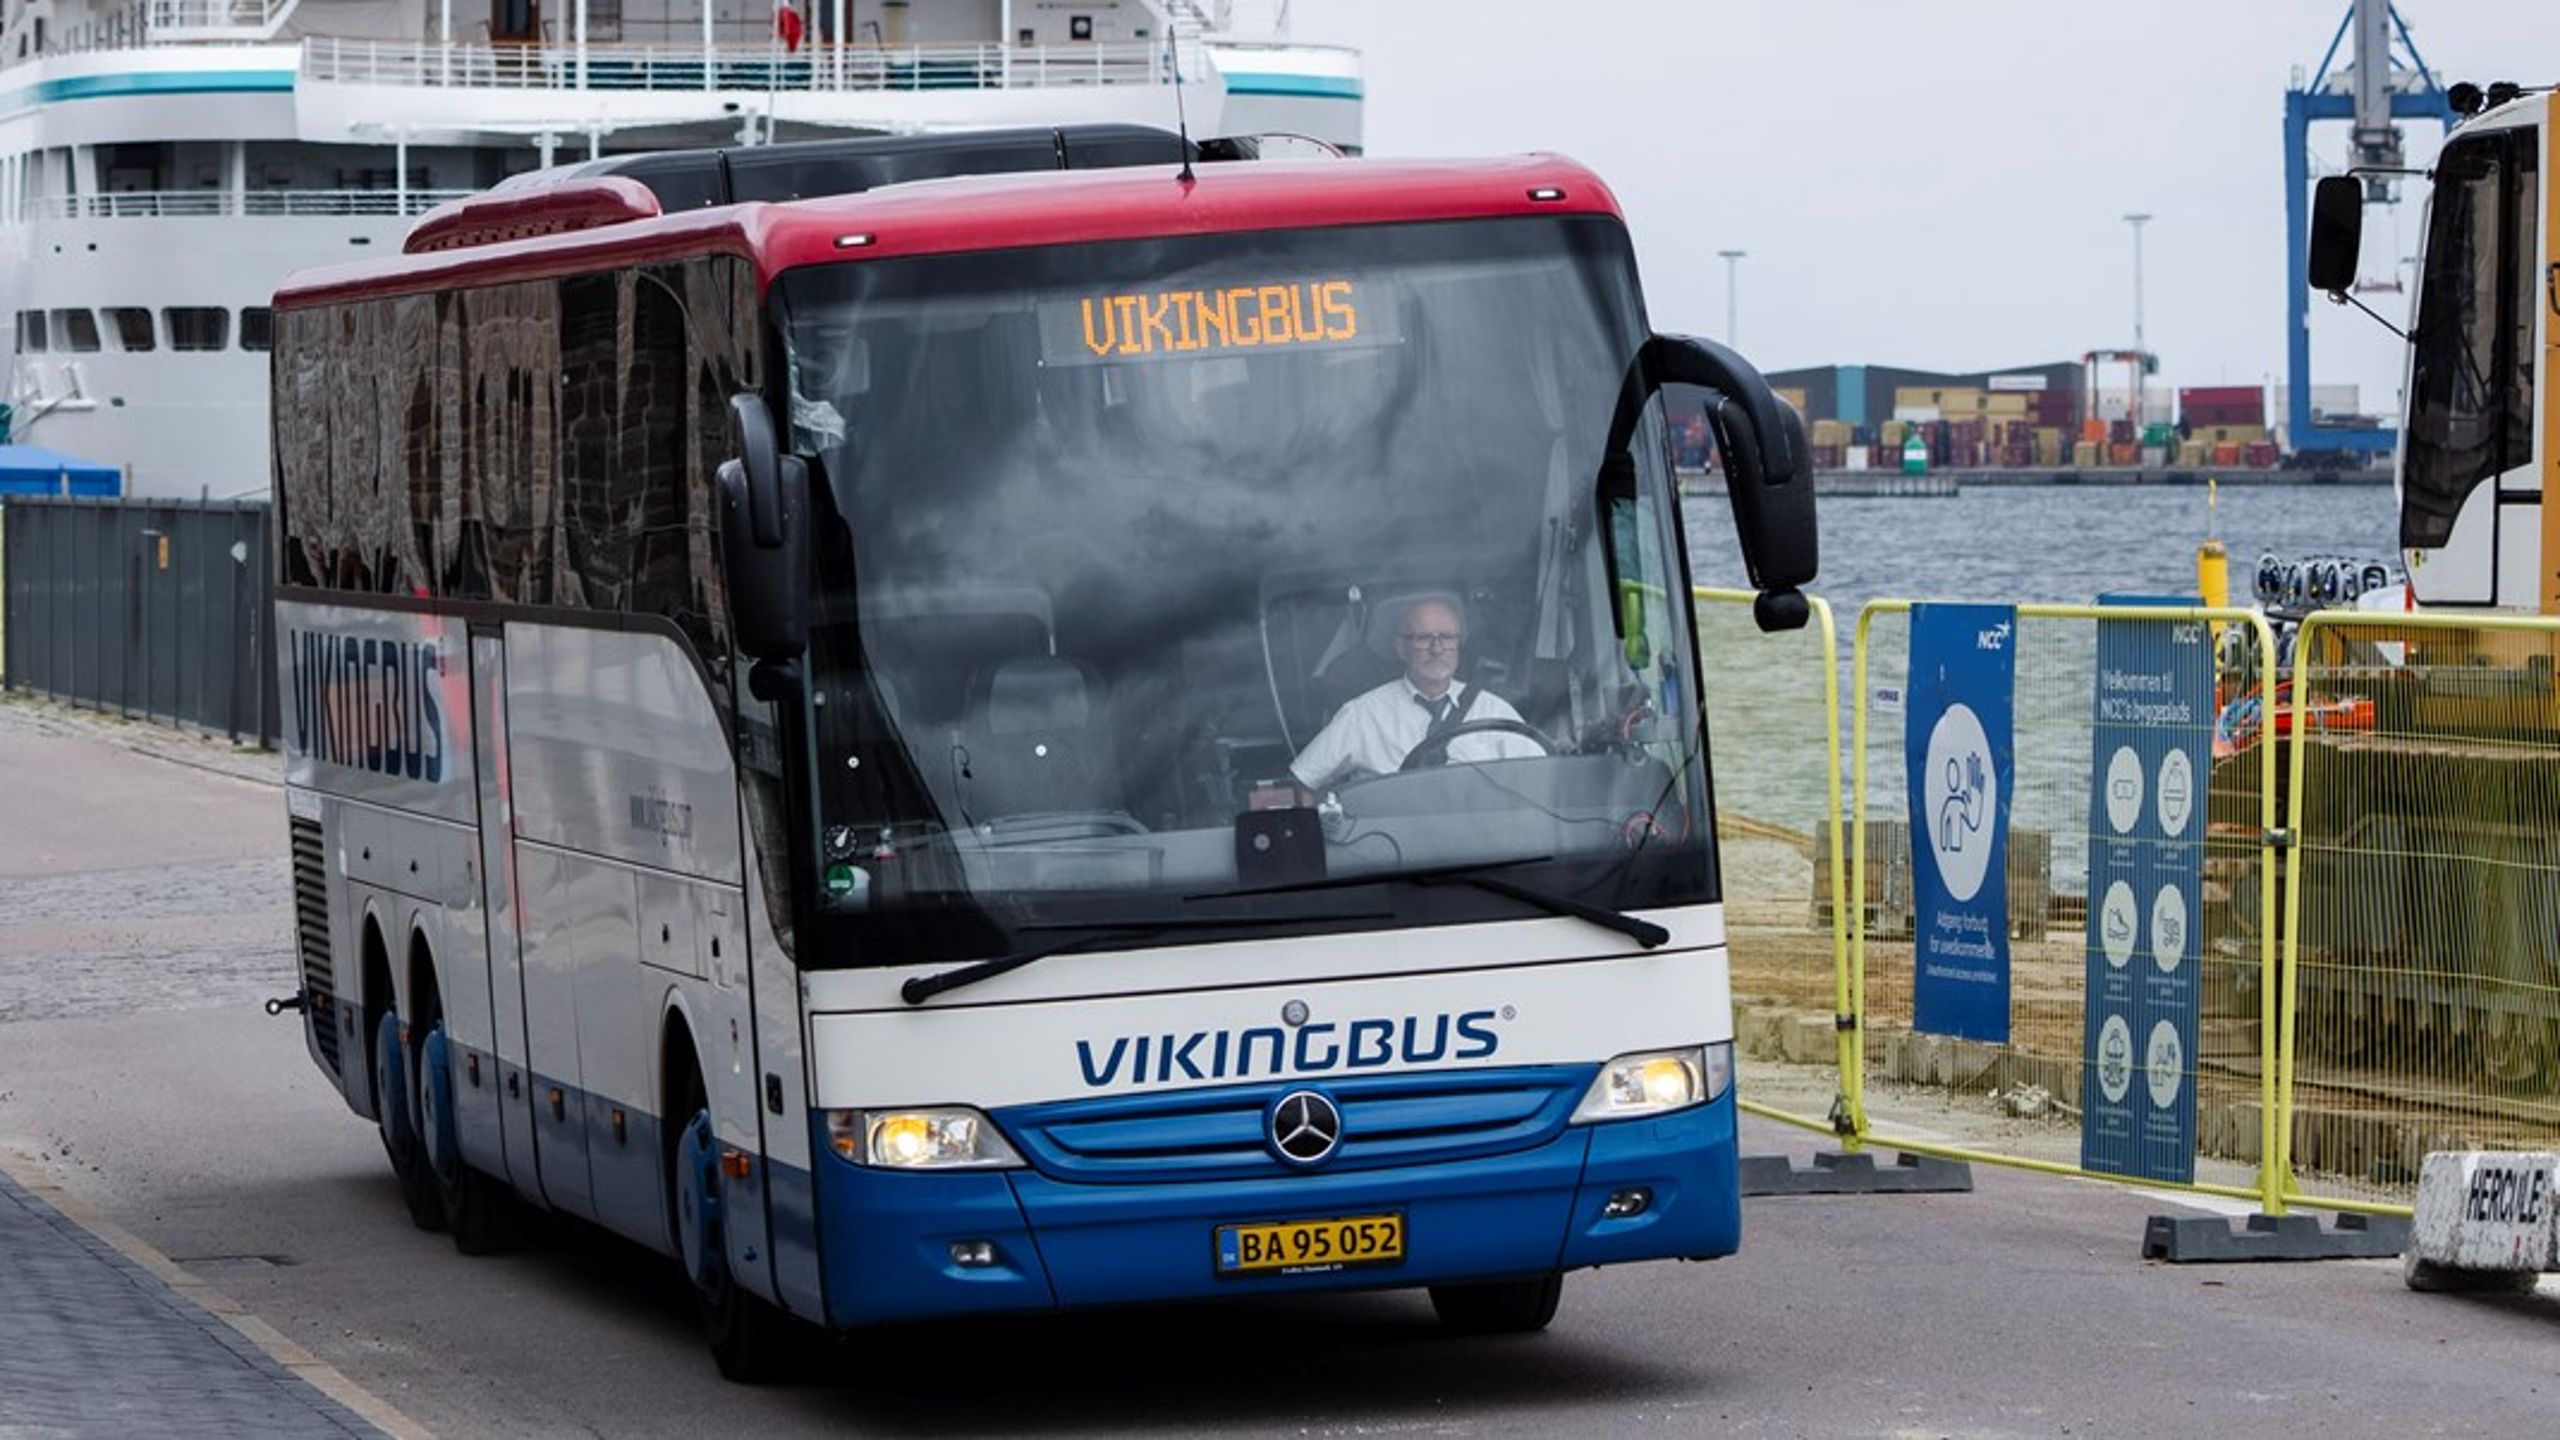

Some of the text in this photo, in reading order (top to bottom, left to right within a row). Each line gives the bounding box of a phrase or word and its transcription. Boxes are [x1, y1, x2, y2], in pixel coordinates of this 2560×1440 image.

[1081, 281, 1357, 355] VIKINGBUS
[1977, 630, 2001, 649] NCC
[2172, 624, 2201, 643] NCC
[290, 628, 442, 783] VIKINGBUS
[1243, 1223, 1397, 1262] BA 95 052
